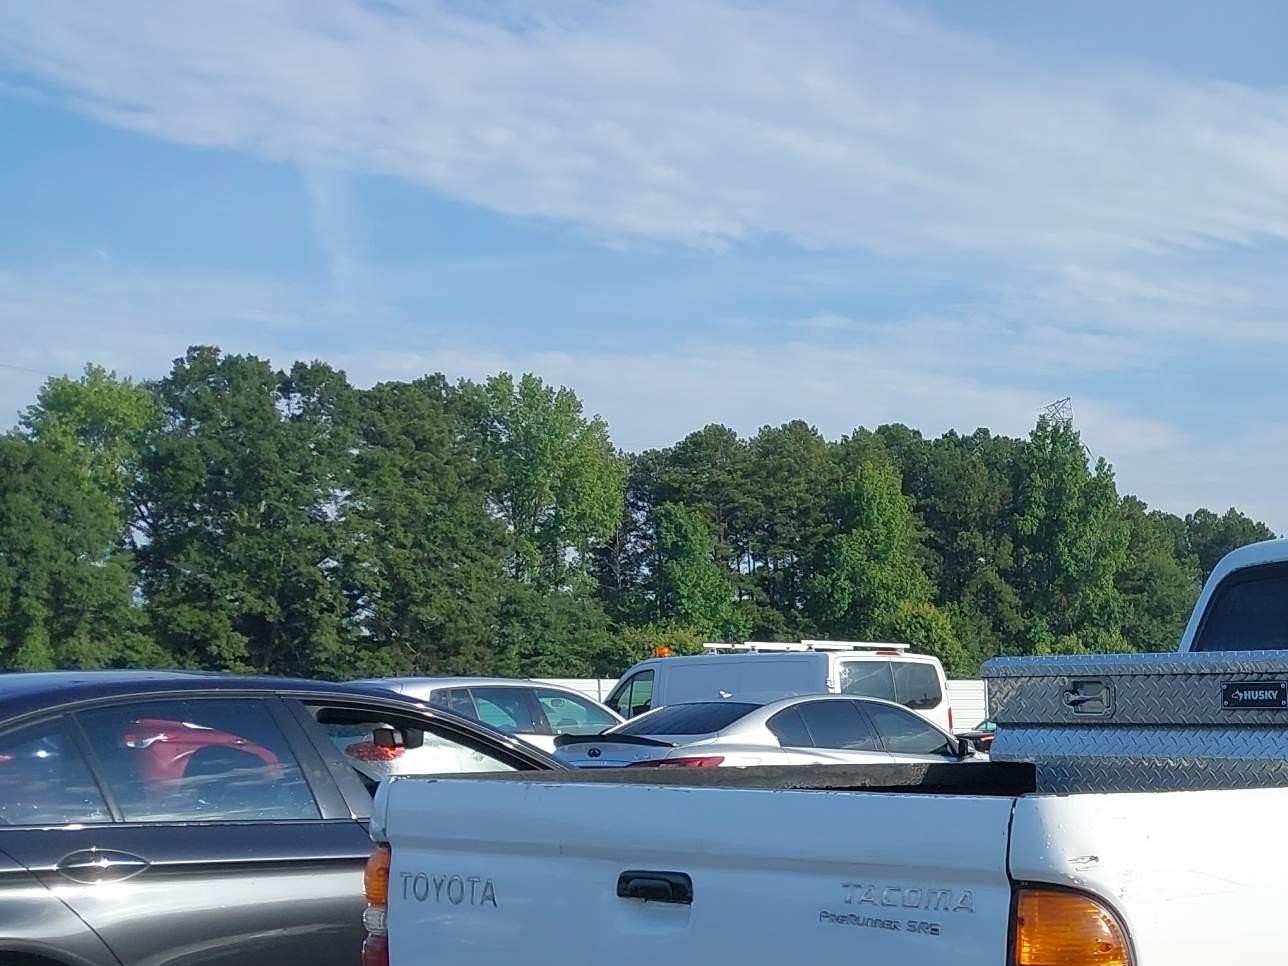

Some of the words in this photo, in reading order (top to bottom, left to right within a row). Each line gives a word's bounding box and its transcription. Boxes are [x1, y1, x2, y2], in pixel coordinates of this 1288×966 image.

[1243, 690, 1279, 700] HUSKY
[400, 871, 498, 908] TOYOTA
[841, 881, 976, 913] TACOMA
